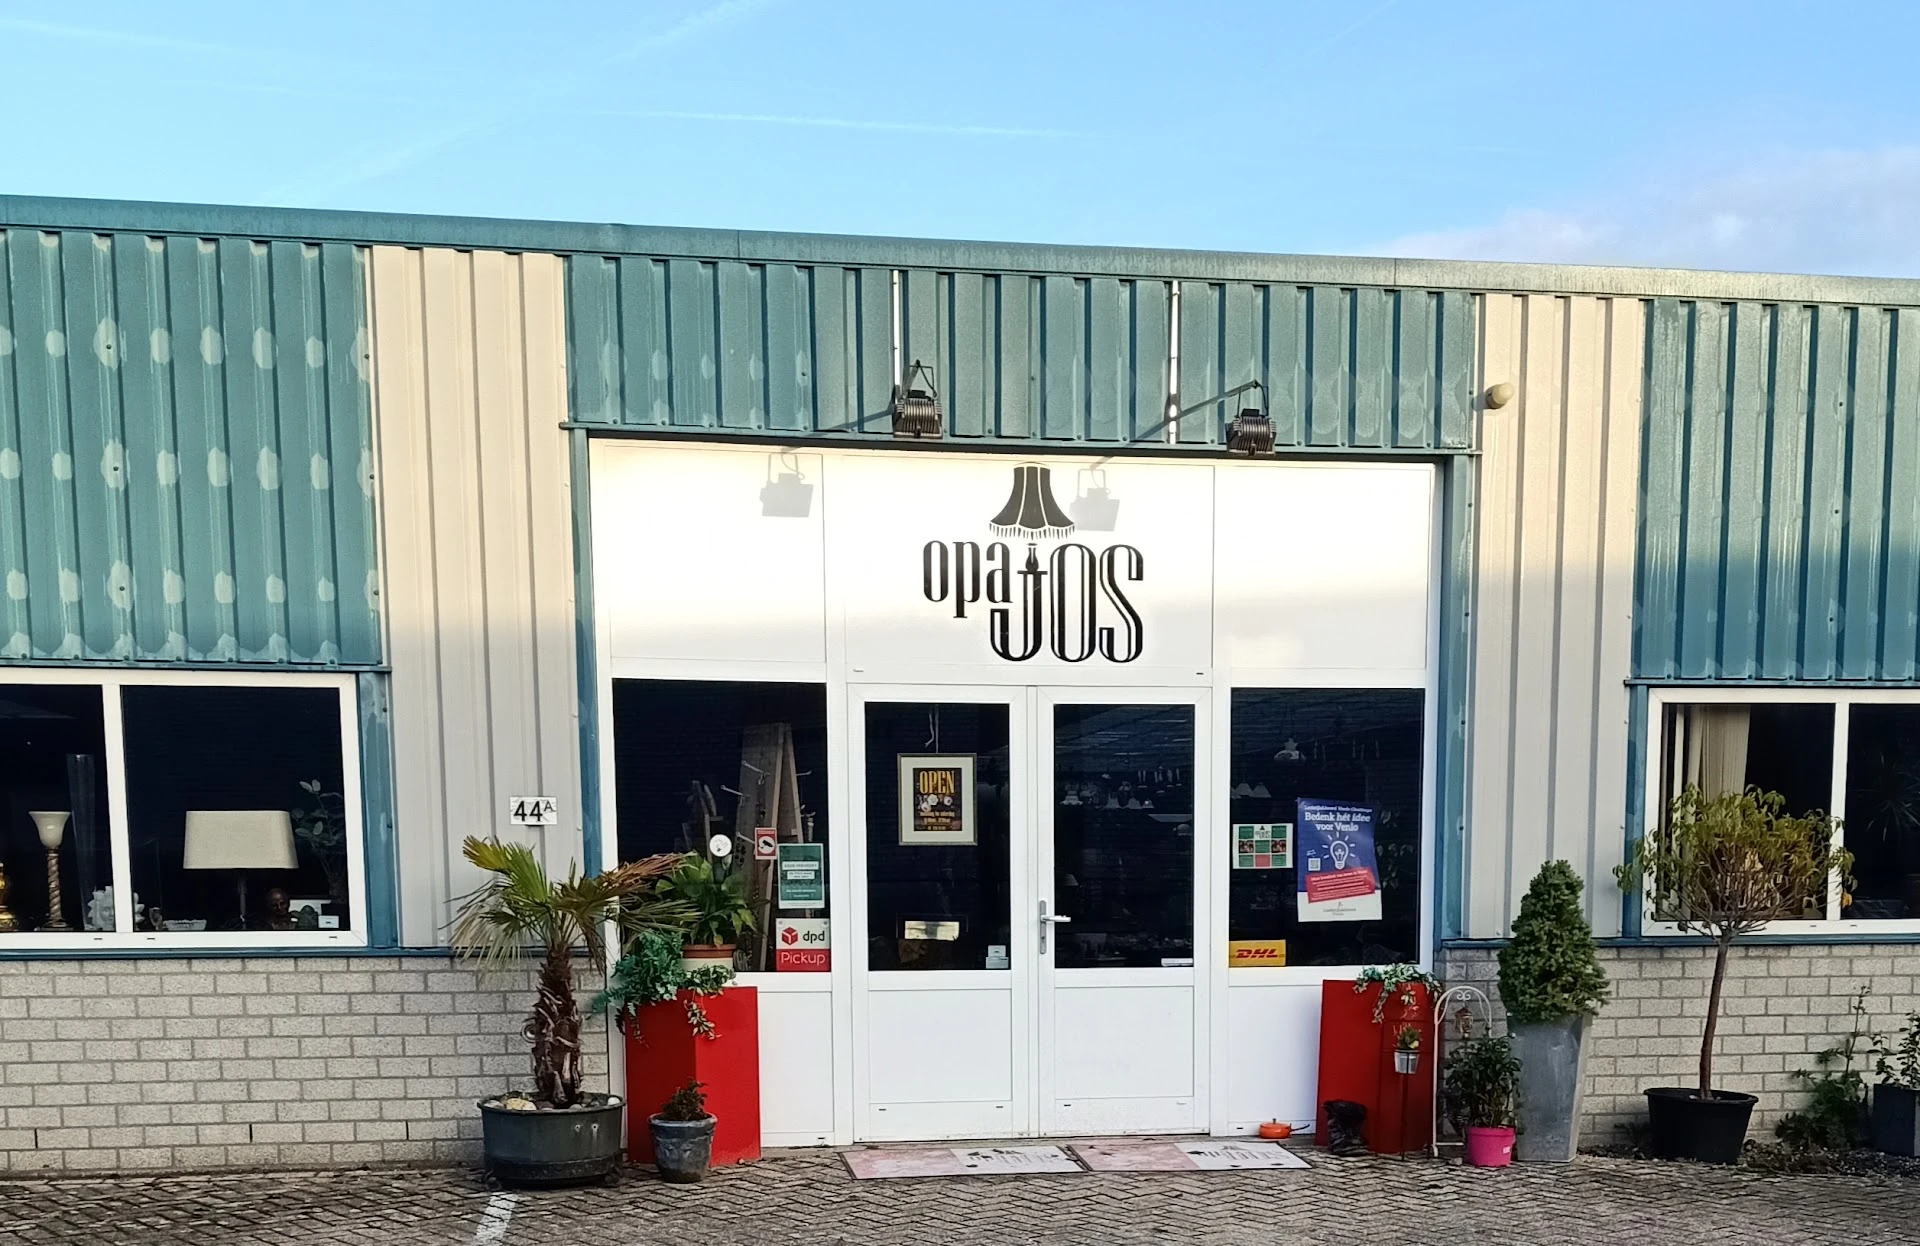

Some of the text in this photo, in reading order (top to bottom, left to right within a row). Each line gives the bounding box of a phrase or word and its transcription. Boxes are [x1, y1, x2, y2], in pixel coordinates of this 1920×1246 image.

[923, 540, 1013, 618] opa
[990, 543, 1144, 663] JOS
[919, 770, 955, 794] OPEN
[1304, 811, 1371, 823] Bedenk hét idee
[1315, 822, 1359, 832] voor Venlo
[802, 930, 825, 944] dpd
[780, 951, 826, 966] Pickup
[1235, 948, 1279, 959] DHL
